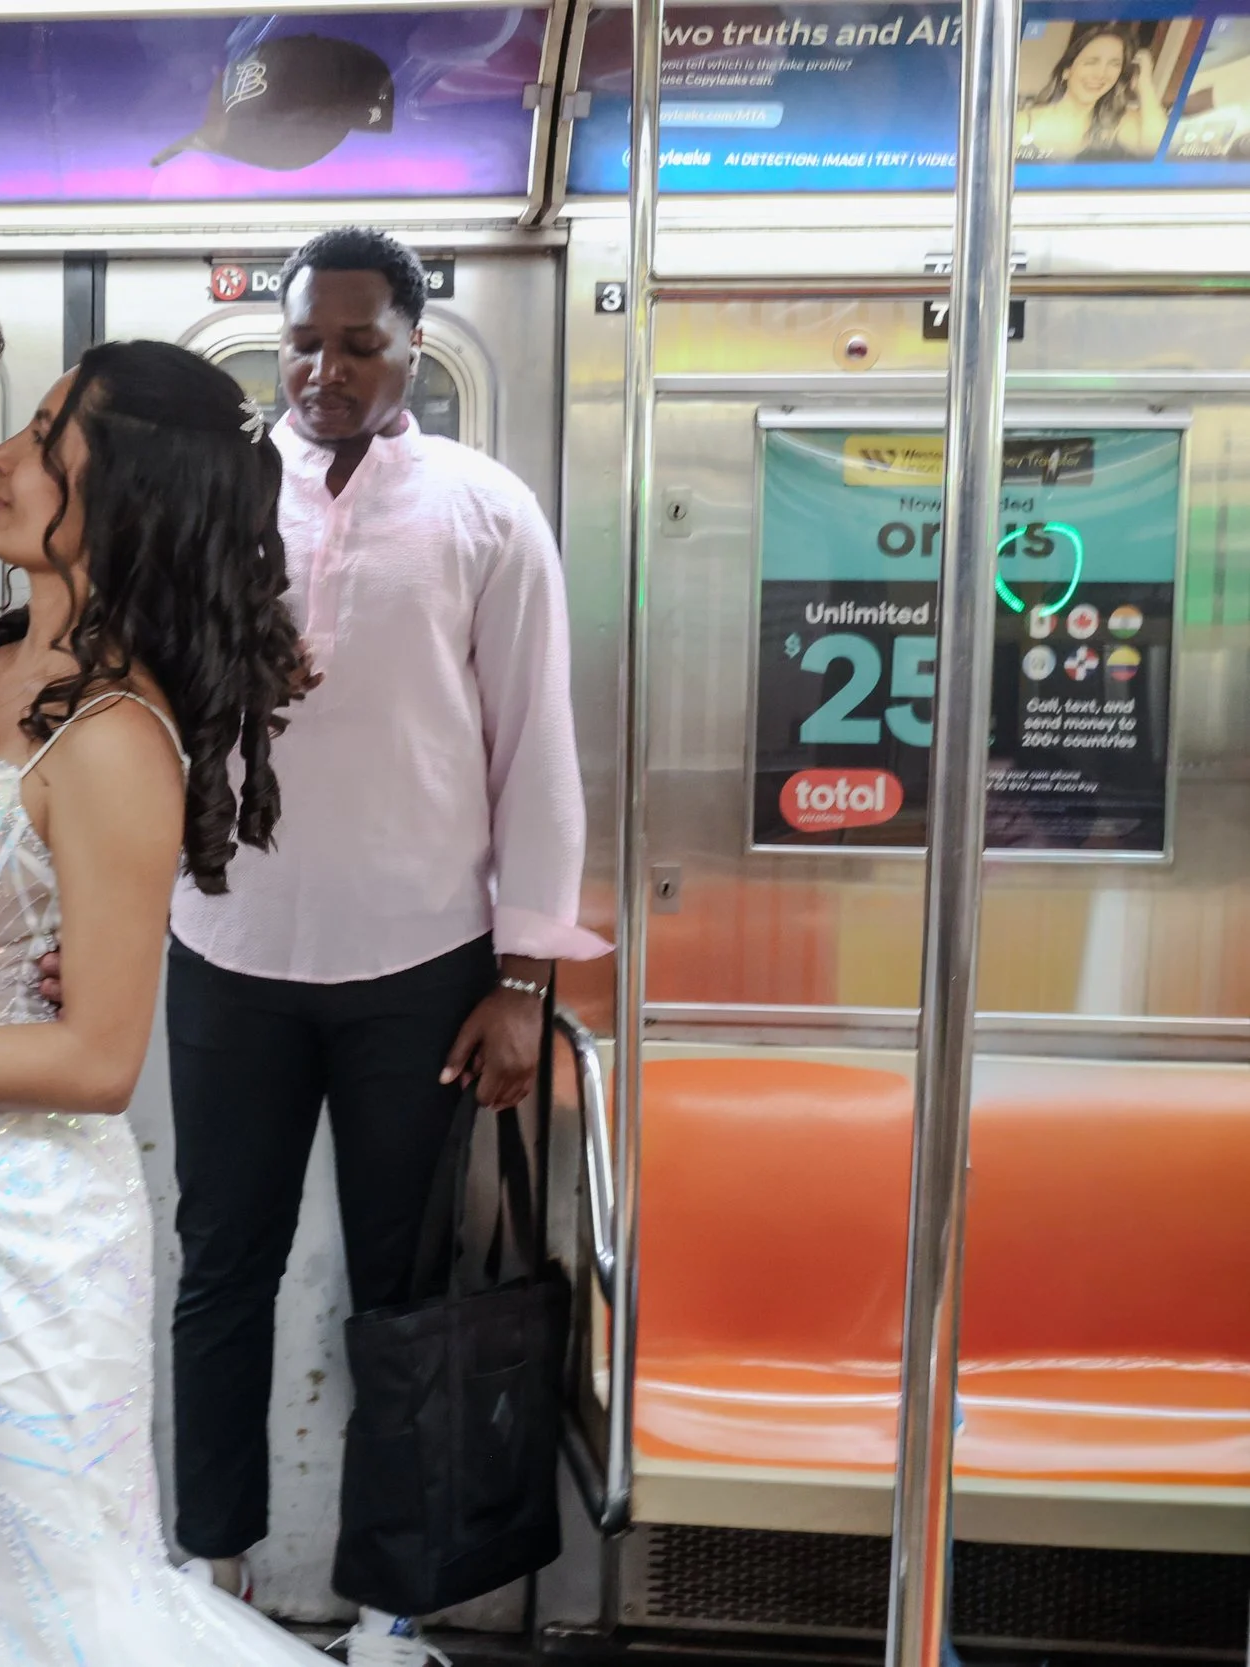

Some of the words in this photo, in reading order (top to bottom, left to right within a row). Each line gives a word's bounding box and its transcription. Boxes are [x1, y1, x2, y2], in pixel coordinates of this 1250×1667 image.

[661, 20, 715, 47] wo
[722, 16, 829, 46] truths
[835, 15, 903, 46] and
[686, 58, 706, 71] tell
[707, 58, 743, 71] which
[757, 57, 776, 71] the
[778, 57, 805, 71] fake
[805, 58, 854, 72] profile?
[685, 73, 749, 87] Copyleaks
[741, 151, 820, 167] DETECTION:
[822, 152, 865, 167] IMAGE
[875, 151, 908, 167] TEXT
[252, 270, 281, 292] Do
[601, 284, 623, 312] 3
[805, 601, 930, 626] Unlimited
[1026, 696, 1062, 715] Call,
[1064, 698, 1100, 715] text,
[1103, 697, 1136, 714] and
[1024, 714, 1063, 730] send
[1063, 716, 1117, 732] money
[1118, 715, 1137, 731] to
[1022, 731, 1061, 747] 200+
[1062, 732, 1137, 748] countries
[795, 774, 888, 812] total
